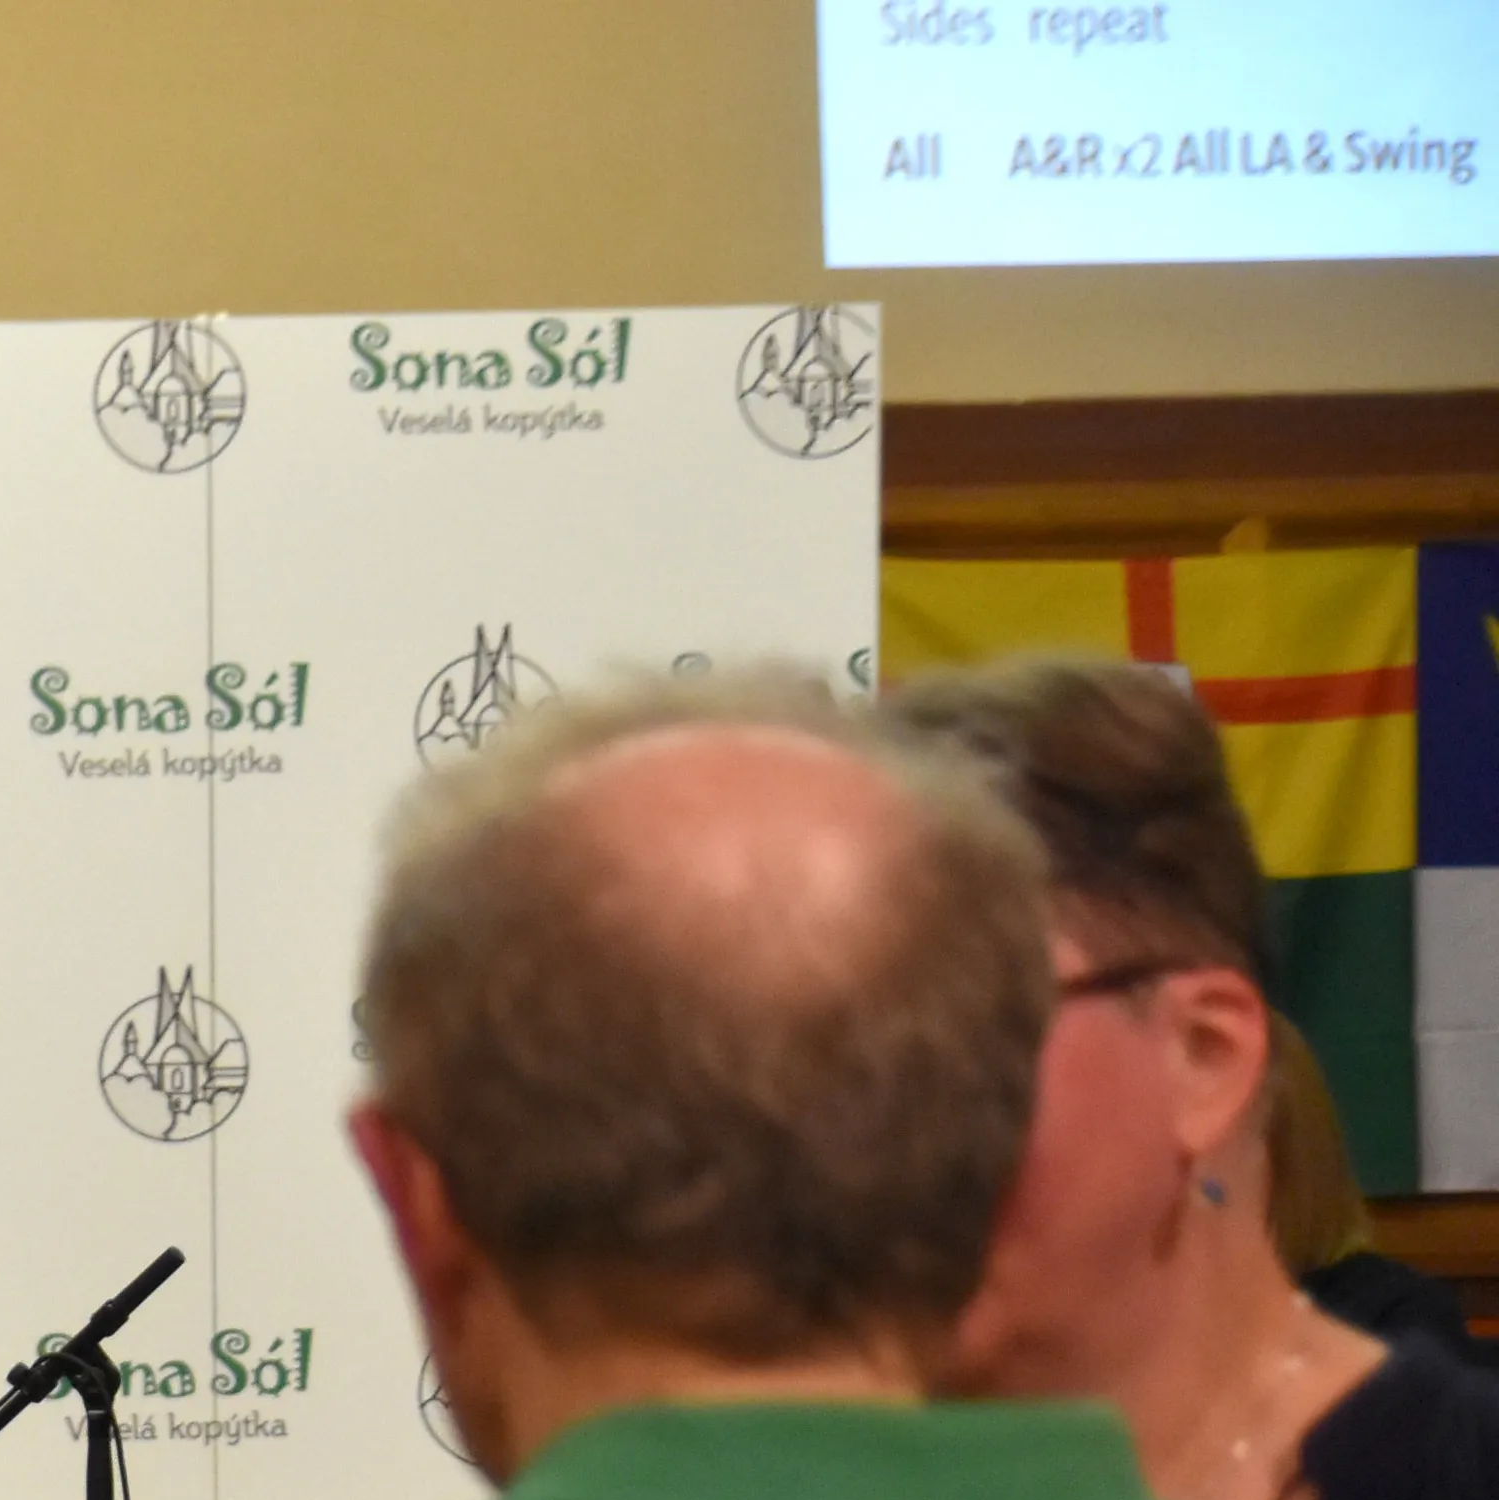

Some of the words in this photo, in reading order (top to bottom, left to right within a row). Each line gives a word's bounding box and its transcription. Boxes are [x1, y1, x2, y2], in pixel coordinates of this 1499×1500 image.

[880, 0, 996, 46] Sides
[1028, 3, 1170, 56] repeat
[884, 133, 941, 178] All
[1171, 128, 1231, 175] All
[1240, 131, 1293, 175] LA
[1302, 131, 1333, 175] &
[1344, 126, 1479, 186] Swing
[350, 322, 511, 392] Sona
[527, 317, 632, 388] Sól
[379, 403, 472, 435] Veselá
[30, 666, 191, 736] Sona
[206, 661, 311, 732] Sól
[58, 747, 151, 779] Veselá
[163, 745, 283, 782] kopýtka
[210, 1328, 313, 1397] Sól
[64, 1412, 158, 1442] Velá
[168, 1411, 289, 1446] kopýtka
